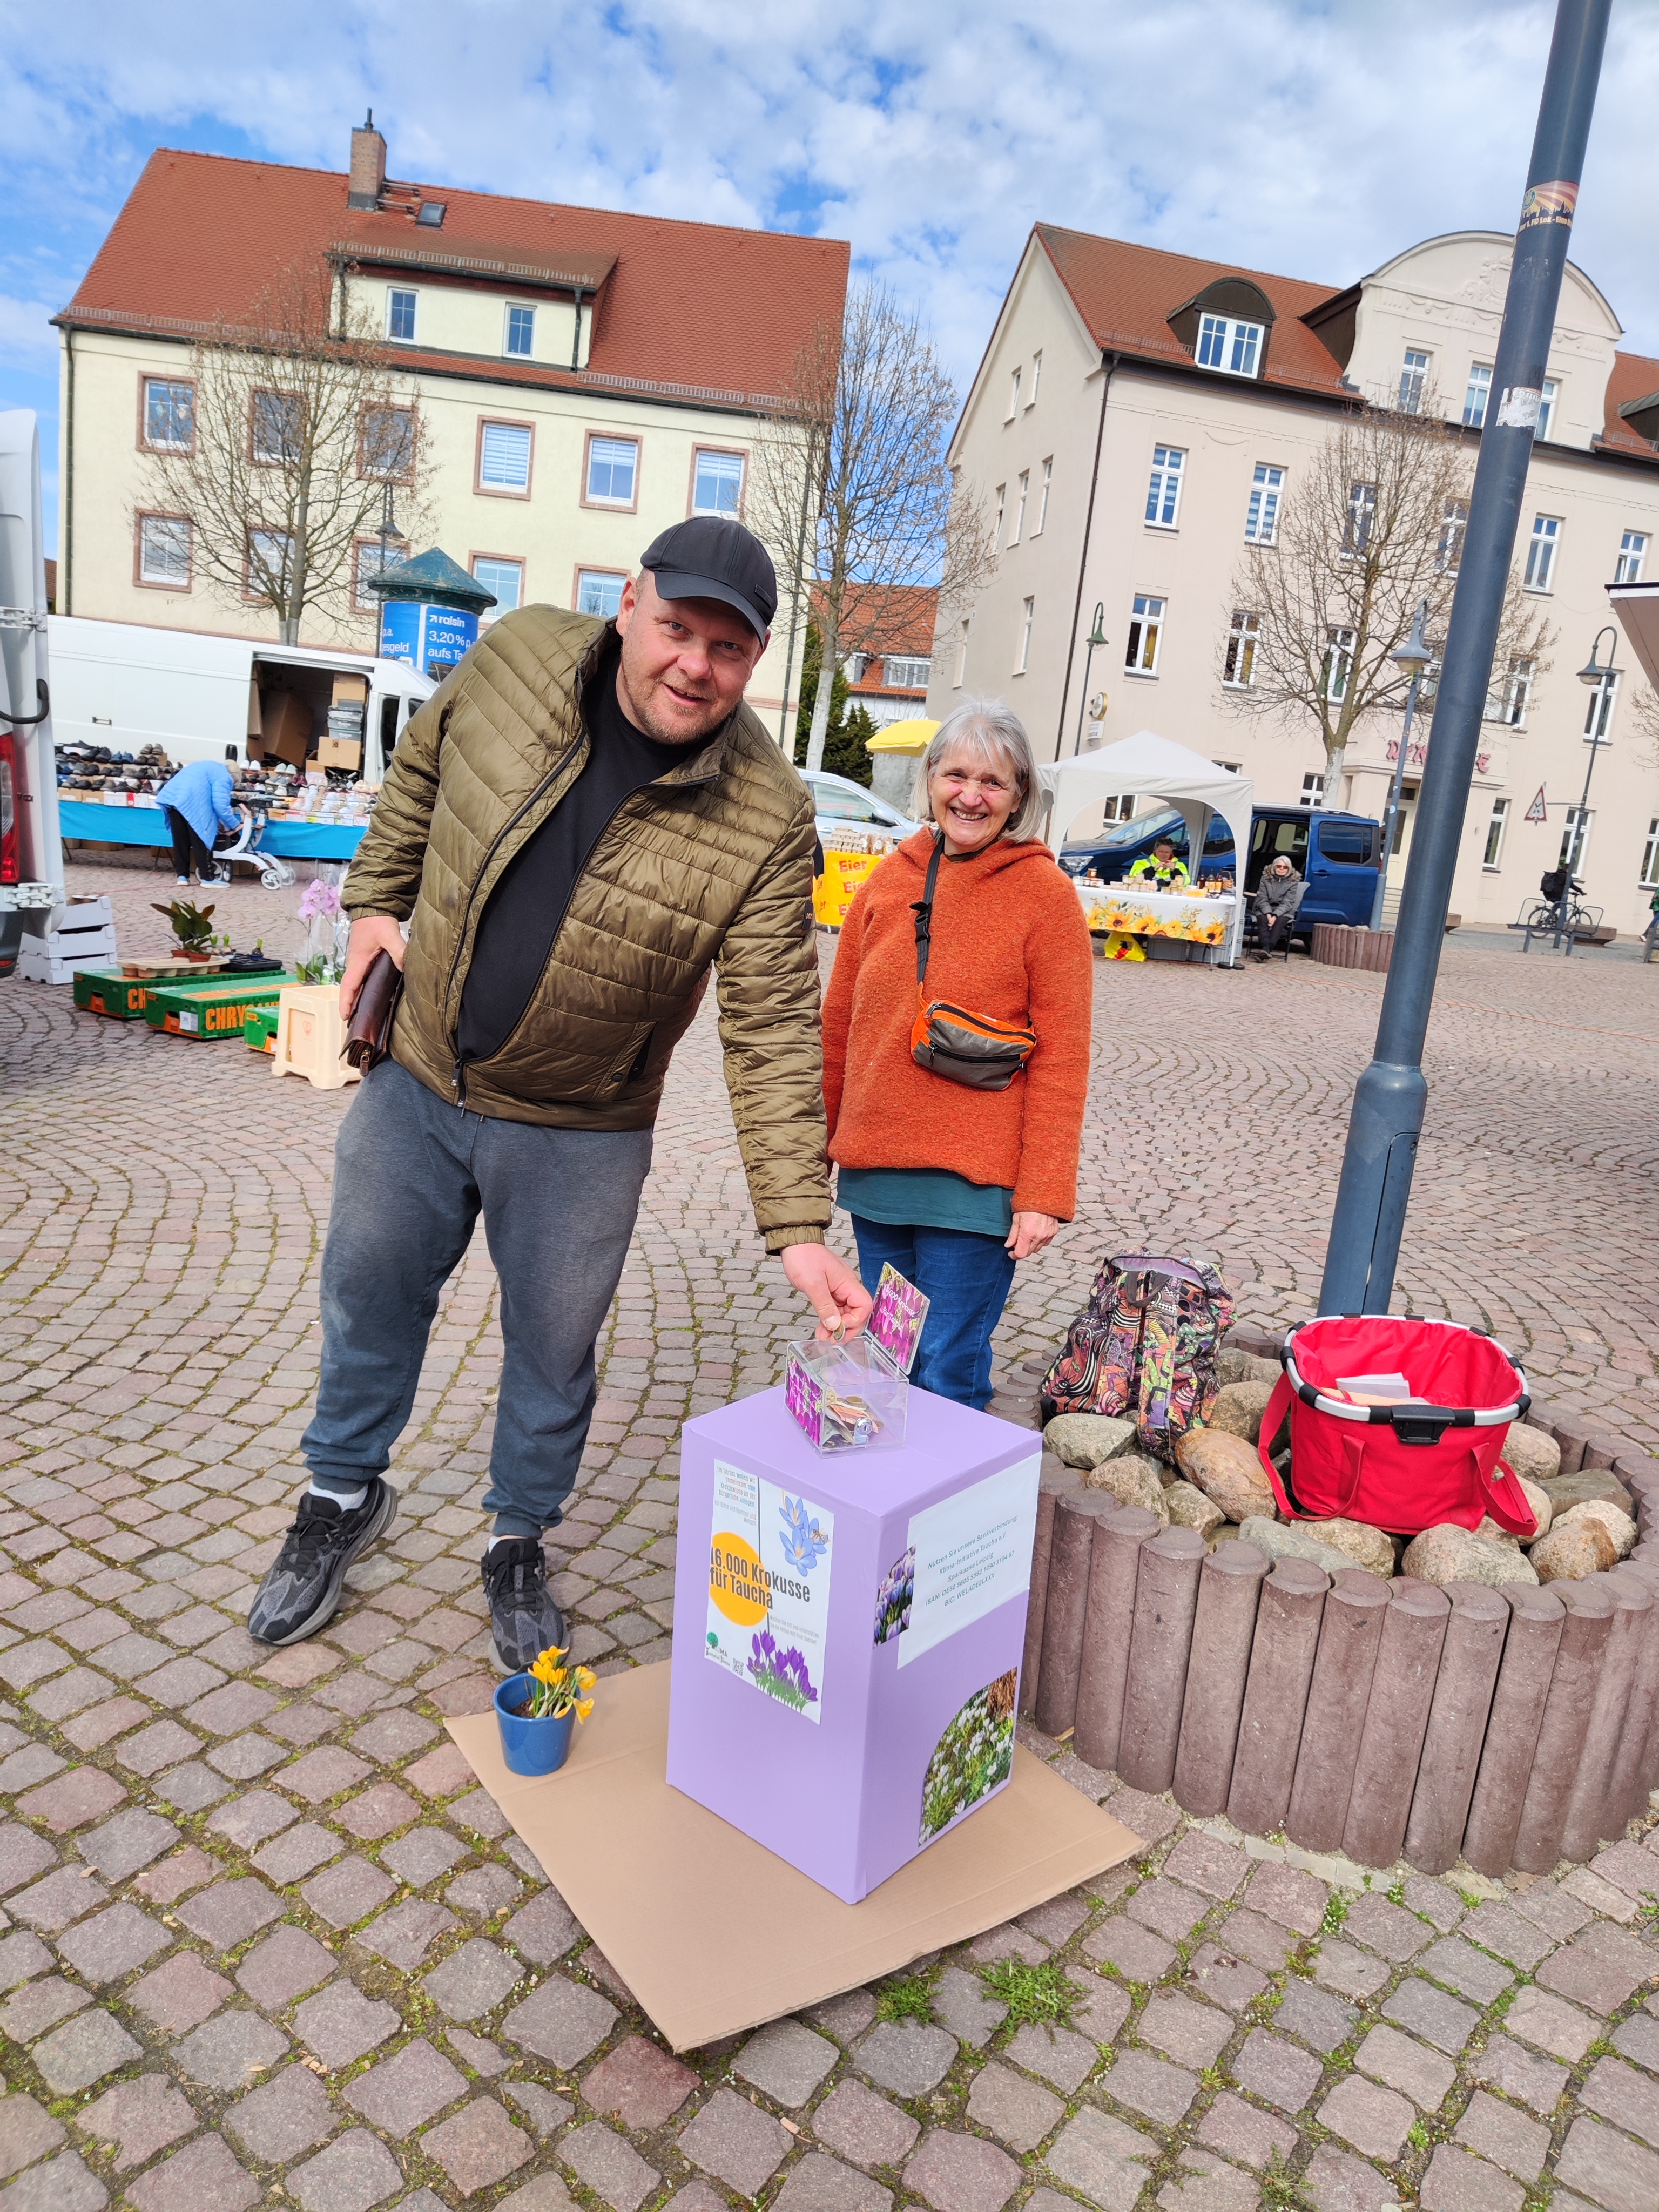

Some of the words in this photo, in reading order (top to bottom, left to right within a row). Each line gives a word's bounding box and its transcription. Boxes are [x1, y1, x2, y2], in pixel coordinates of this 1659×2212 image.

[1531, 218, 1539, 226] FC
[439, 615, 465, 628] raisin
[428, 648, 451, 659] aufs
[839, 860, 867, 873] Eier
[206, 1003, 254, 1030] CHRY
[898, 1297, 915, 1317] Krokusse
[928, 1555, 948, 1569] Nutzen
[957, 1539, 975, 1553] unsere
[976, 1515, 1018, 1542] Bankverbindung:
[939, 1548, 979, 1575] Klima-Initiative
[980, 1537, 997, 1552] Taucha
[998, 1532, 1007, 1541] e.V.
[711, 1547, 748, 1578] 16.000
[751, 1562, 810, 1602] Krokusse
[948, 1563, 975, 1582] Sparkasse
[976, 1552, 994, 1566] Leipzig
[710, 1567, 727, 1590] für
[730, 1574, 773, 1610] Taucha
[926, 1593, 941, 1606] IBAN:
[942, 1584, 955, 1596] DE50
[945, 1596, 956, 1607] BIC:
